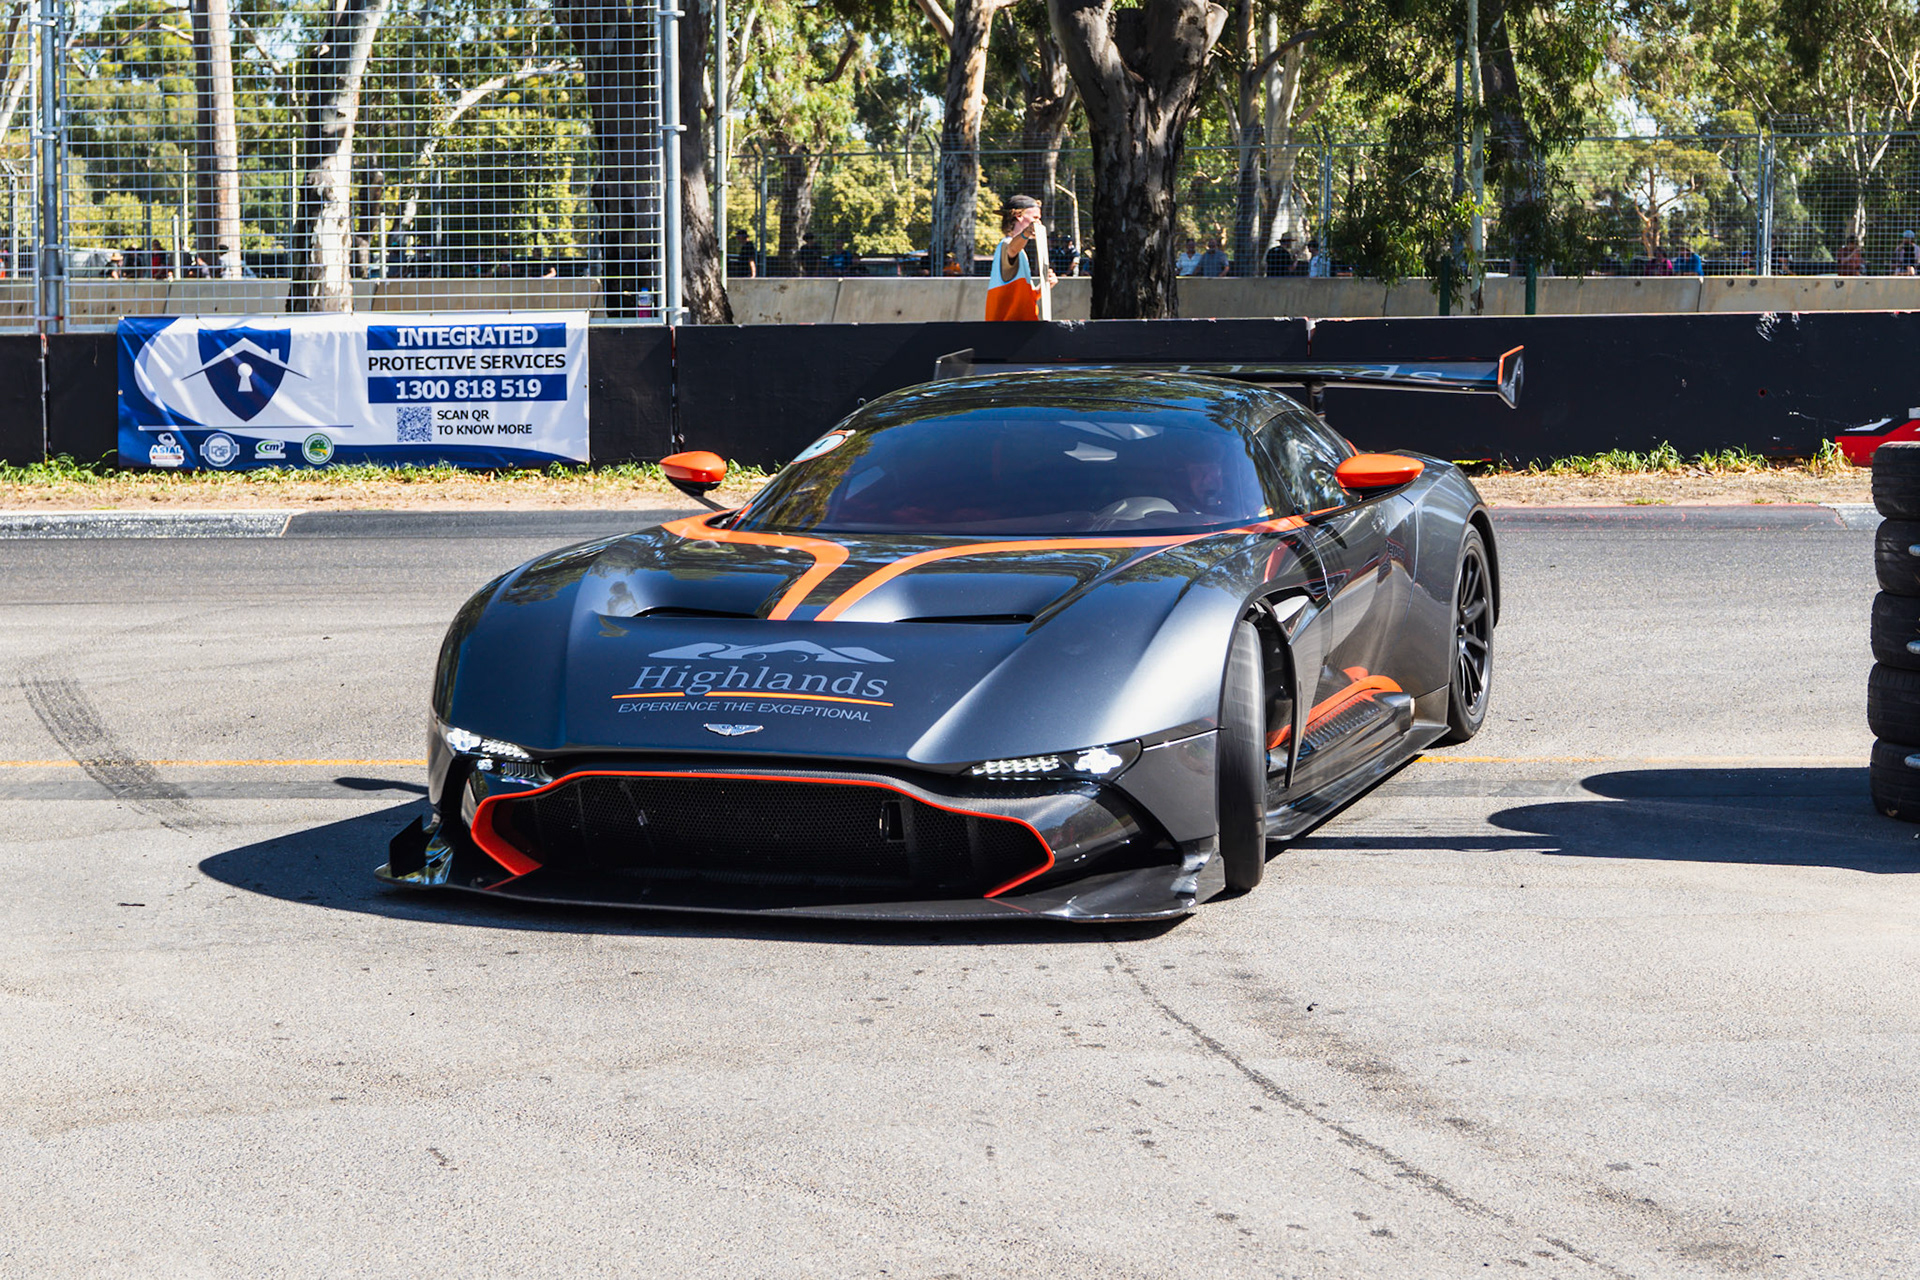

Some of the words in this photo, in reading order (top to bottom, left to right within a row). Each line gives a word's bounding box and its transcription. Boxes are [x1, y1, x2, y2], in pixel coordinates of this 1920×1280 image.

[396, 325, 538, 347] INTEGRATED
[368, 355, 476, 371] PROTECTIVE
[480, 353, 567, 370] SERVICES
[396, 380, 450, 400] 1300
[454, 379, 497, 399] 818
[501, 378, 542, 399] 519
[437, 409, 469, 421] SCAN
[471, 409, 490, 422] QR
[437, 424, 454, 435] TO
[456, 424, 495, 435] KNOW
[497, 423, 533, 435] MORE
[152, 446, 181, 454] ASIAL
[628, 665, 889, 698] Highlands
[618, 701, 720, 713] EXPERIENCE
[723, 701, 756, 712] THE
[758, 702, 871, 722] EXCEPTIONAL
